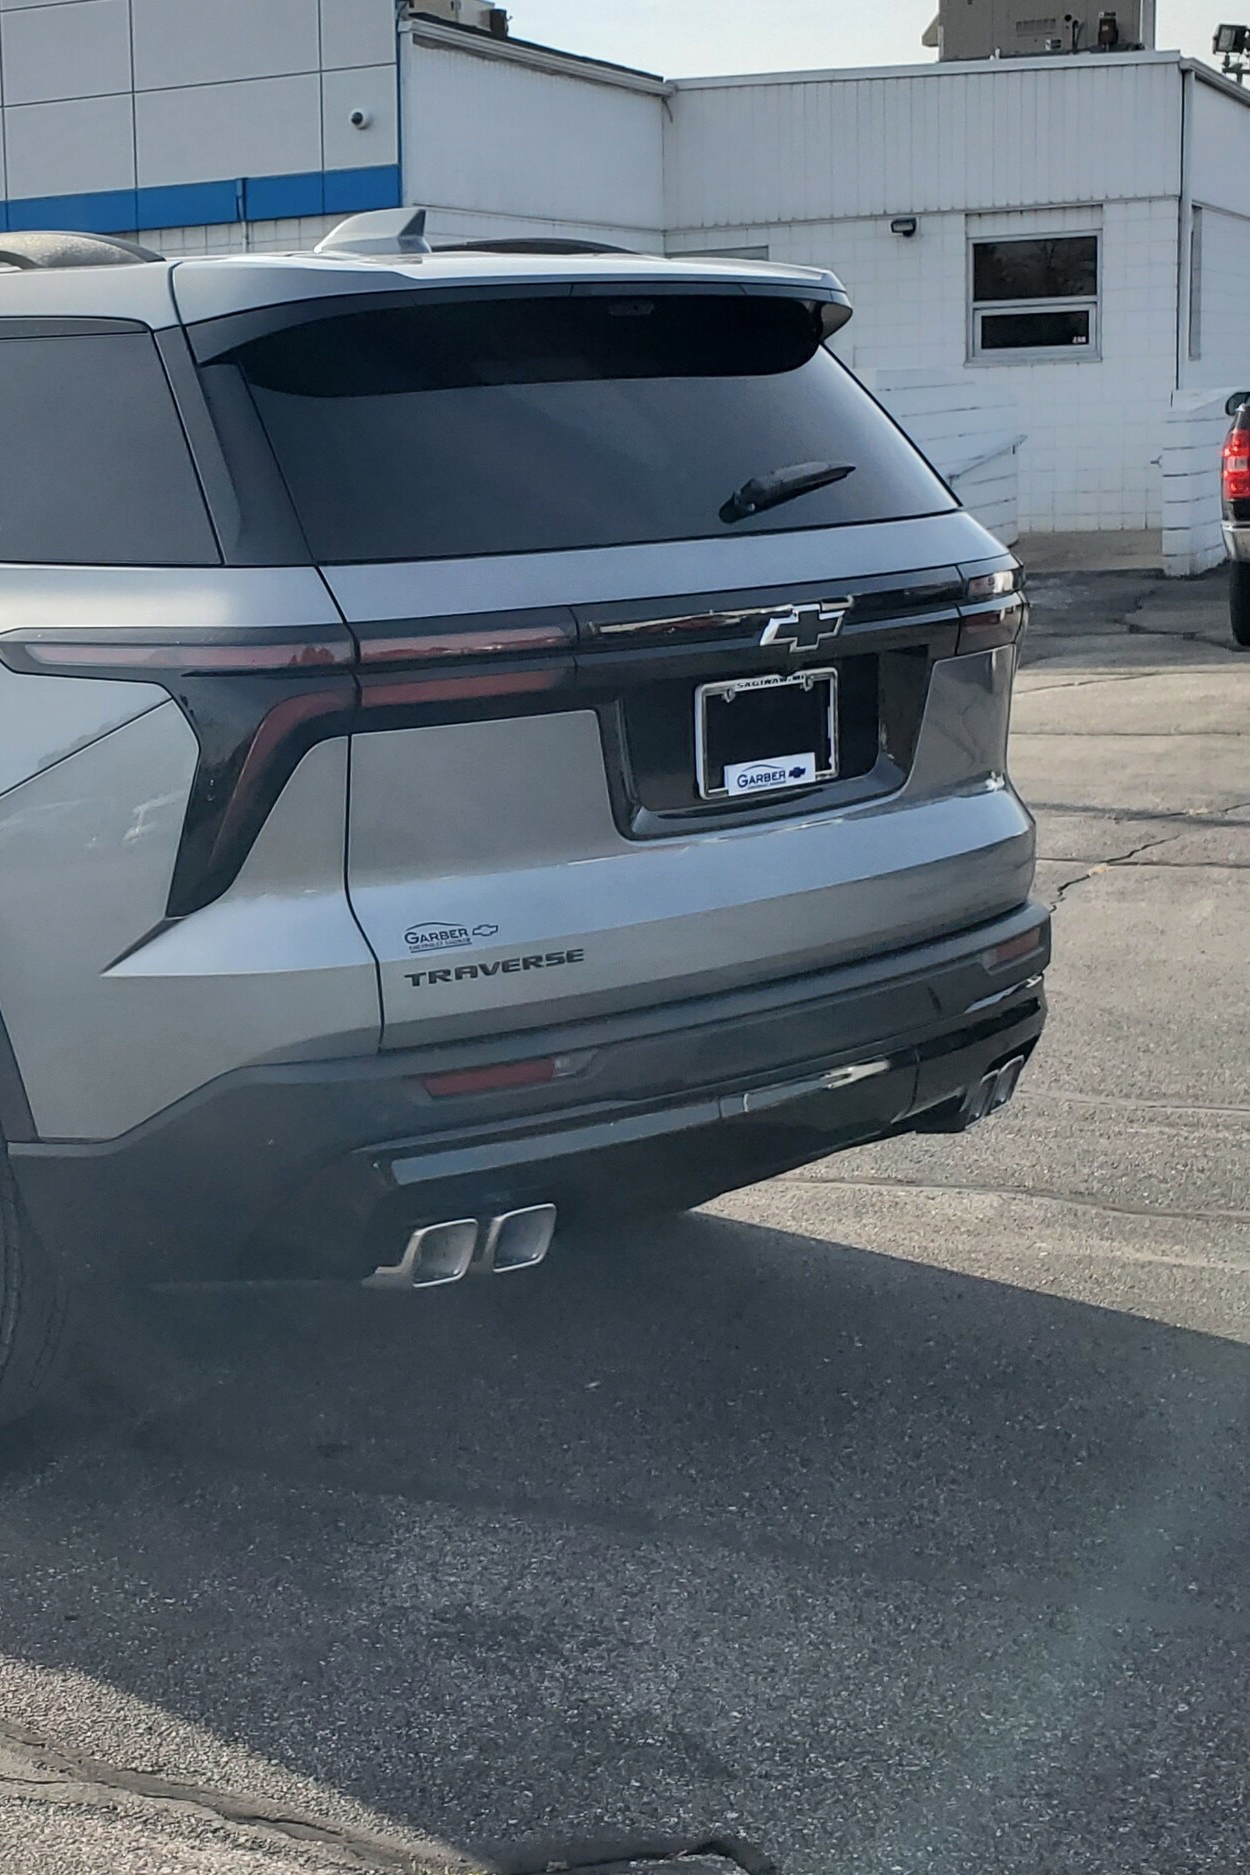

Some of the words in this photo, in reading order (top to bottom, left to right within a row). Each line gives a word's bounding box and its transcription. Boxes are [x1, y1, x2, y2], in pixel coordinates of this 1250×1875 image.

[737, 769, 786, 788] GARBER
[404, 928, 469, 944] GARBER
[404, 948, 585, 987] TRAVERSE
